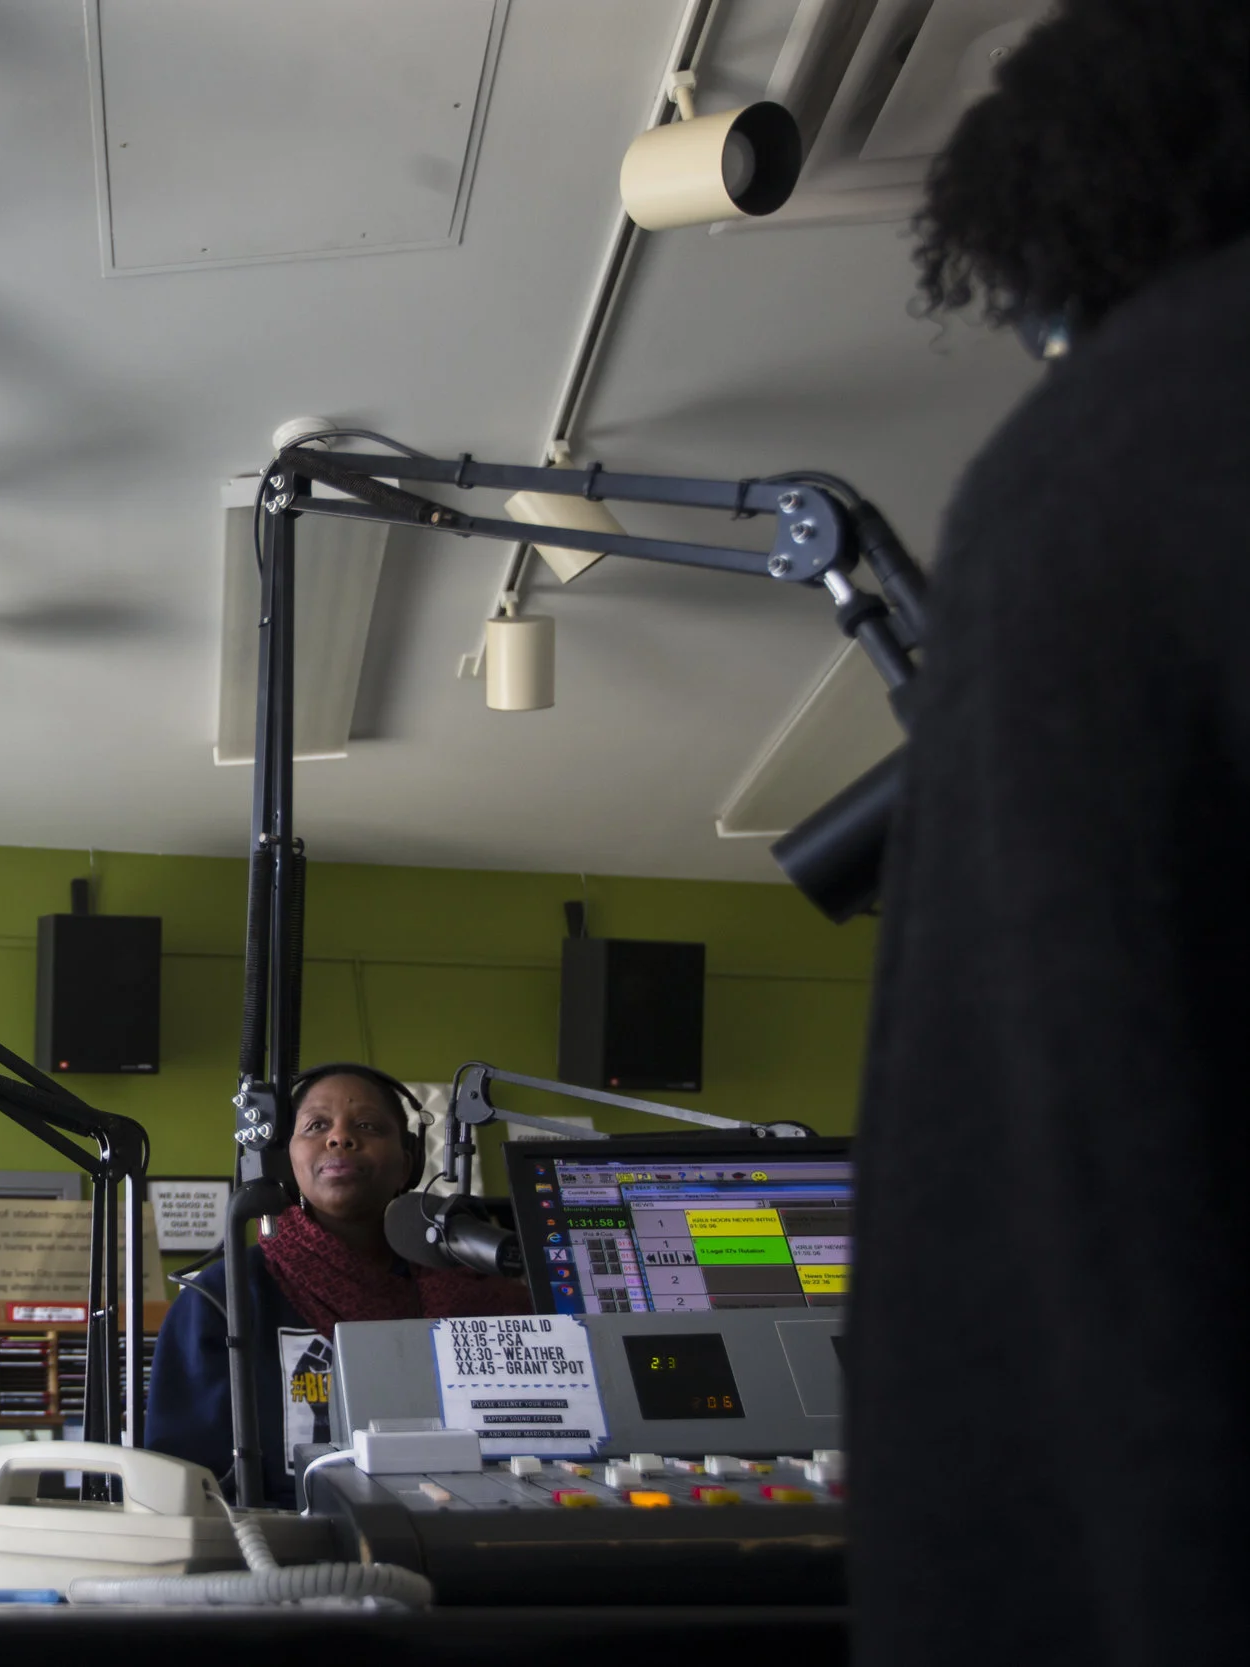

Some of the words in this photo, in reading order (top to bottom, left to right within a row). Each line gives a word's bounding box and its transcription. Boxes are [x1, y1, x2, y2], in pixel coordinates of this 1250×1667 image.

[162, 1211, 188, 1219] WHAT
[567, 1219, 614, 1228] 1:31:58
[658, 1219, 663, 1228] 1
[671, 1276, 679, 1285] 2
[677, 1297, 685, 1306] 2
[540, 1319, 552, 1333] ID
[553, 1360, 585, 1375] SPOT
